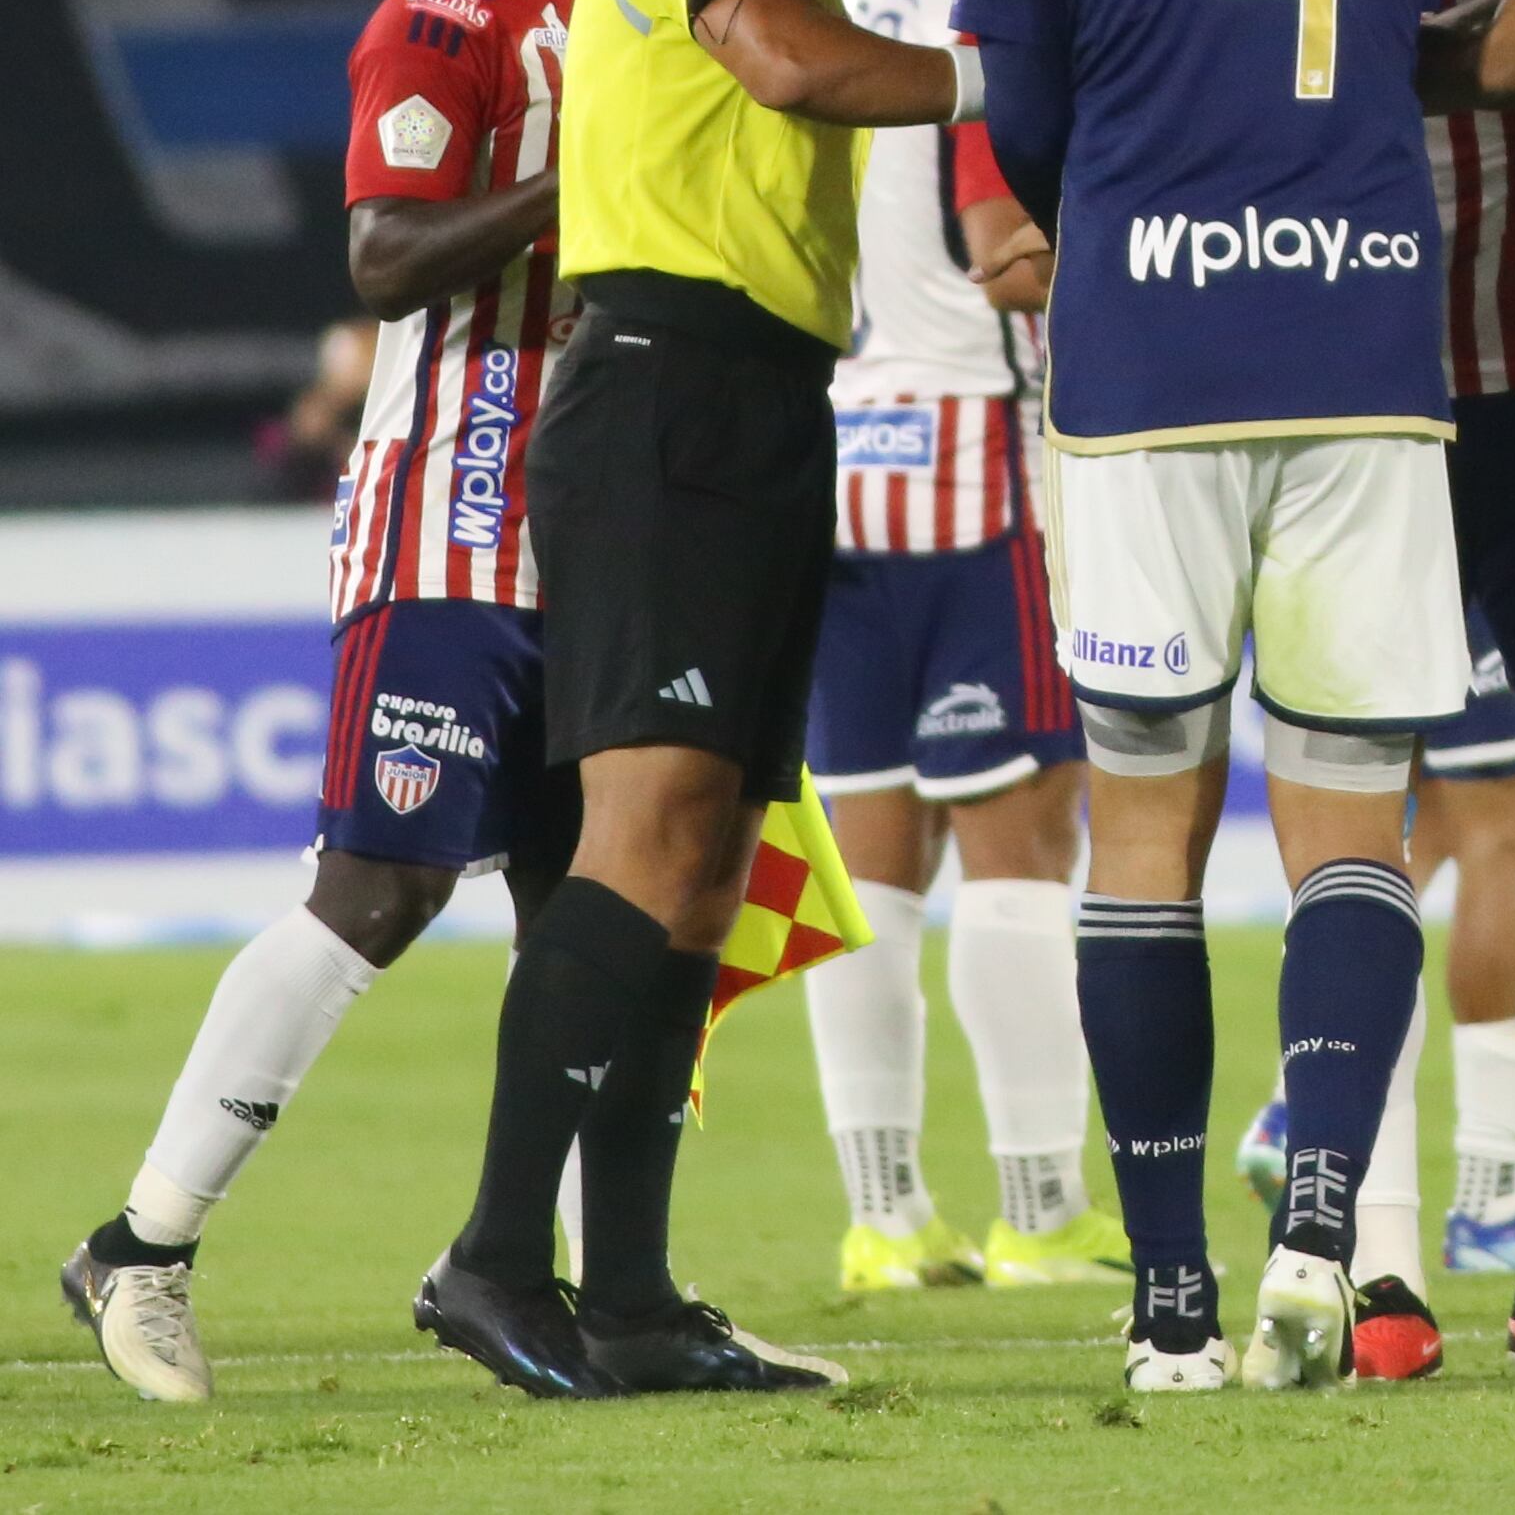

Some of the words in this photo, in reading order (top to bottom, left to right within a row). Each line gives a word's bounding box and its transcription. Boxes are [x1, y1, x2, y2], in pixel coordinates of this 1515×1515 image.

[1129, 206, 1419, 287] Wplay.co
[453, 346, 516, 543] Wplay.co
[377, 692, 457, 722] expreso
[371, 708, 485, 759] brasilia
[386, 766, 428, 782] JUNIOR
[1147, 1282, 1204, 1319] FC
